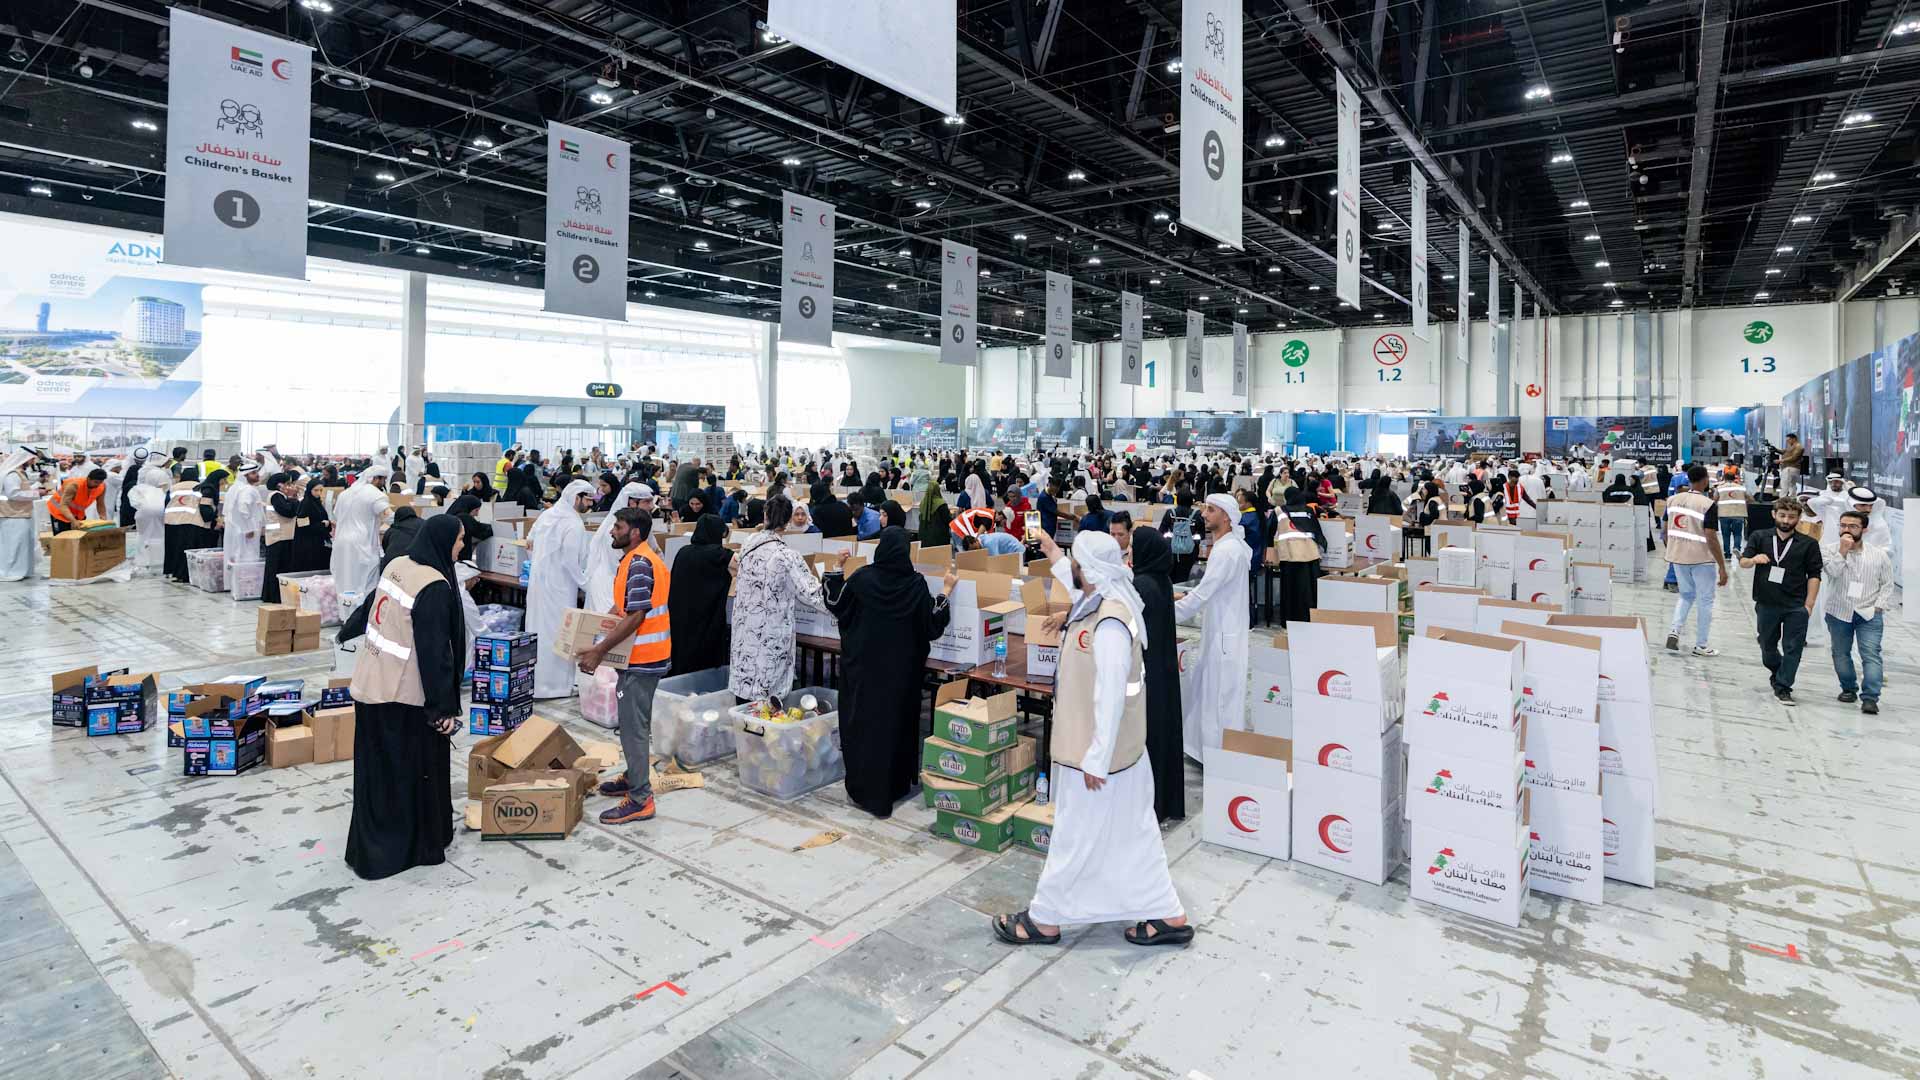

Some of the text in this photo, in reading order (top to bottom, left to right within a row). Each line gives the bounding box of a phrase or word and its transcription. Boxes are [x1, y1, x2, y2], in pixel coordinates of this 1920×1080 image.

[231, 63, 263, 78] UAE AID
[1190, 83, 1237, 125] Children's Basket
[196, 142, 282, 167] سلة الأطفال
[1207, 138, 1220, 173] 2
[184, 155, 292, 184] Children's Basket
[231, 196, 247, 223] 1
[556, 229, 619, 248] Children's Basket
[578, 259, 593, 279] 2
[801, 299, 812, 314] 3
[954, 327, 961, 339] 4
[1740, 356, 1777, 373] 1.3
[1144, 360, 1156, 388] 1
[1284, 371, 1305, 384] 1.1
[1377, 369, 1402, 382] 1.2
[607, 385, 616, 396] A
[1496, 440, 1516, 448] معك
[1626, 432, 1673, 441] #الإمارات
[1613, 441, 1673, 452] معك يا لبنان
[1038, 654, 1057, 664] UAE
[497, 805, 535, 818] NIDO
[1529, 851, 1592, 872] معك يا لبنان
[1444, 868, 1506, 891] معك يا لبنان
